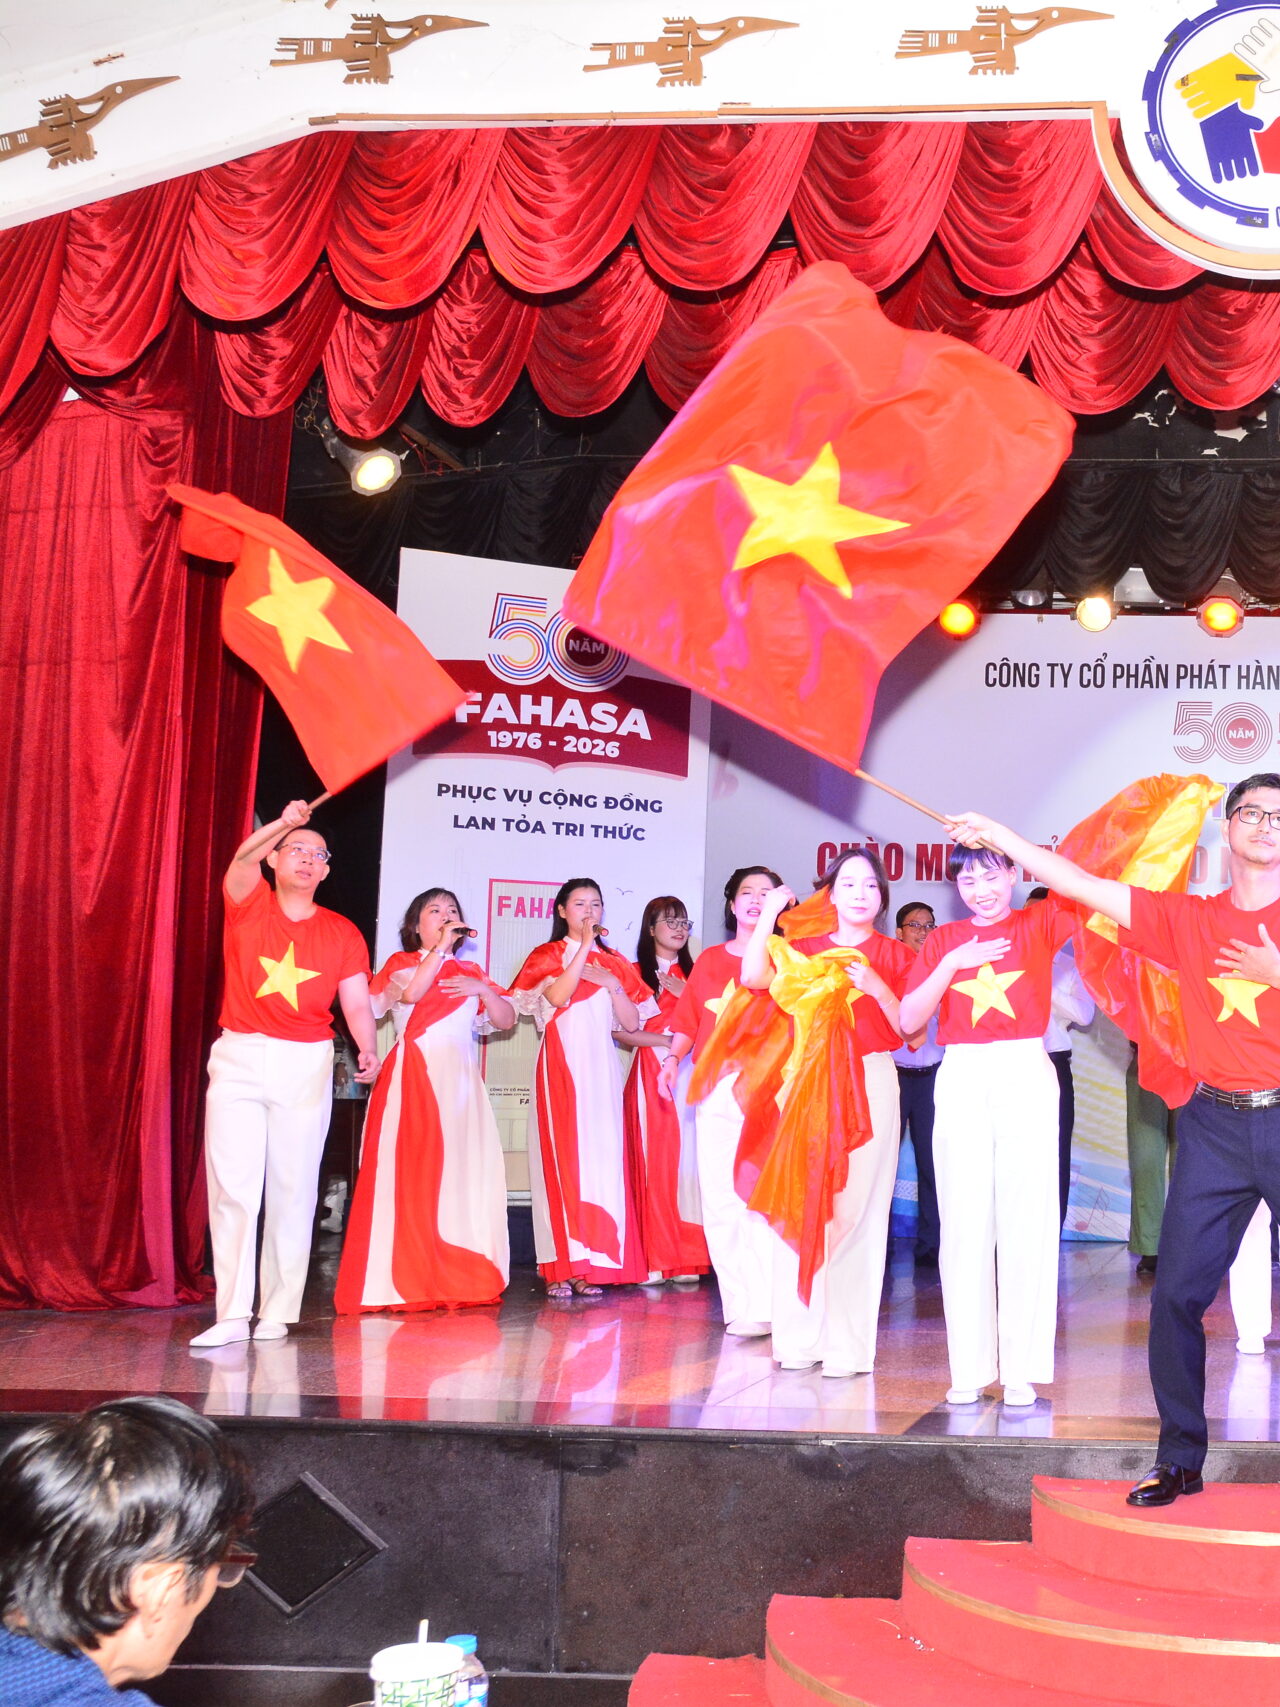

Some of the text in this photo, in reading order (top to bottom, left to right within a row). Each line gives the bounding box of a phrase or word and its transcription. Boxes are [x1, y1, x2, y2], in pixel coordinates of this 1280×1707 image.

[568, 638, 605, 654] NĂM
[984, 657, 1040, 688] CÔNG
[1046, 663, 1073, 688] TY
[1079, 653, 1108, 689] CỔ
[1112, 655, 1169, 689] PHẦN
[1176, 659, 1231, 690] PHÁT
[455, 692, 652, 741] FAHASA
[488, 730, 542, 749] 1976
[563, 735, 621, 758] 2026
[1173, 701, 1273, 765] 50
[1228, 726, 1255, 739] NĂM
[437, 783, 663, 814] PHỤC VỤ CỘNG ĐỒNG
[453, 814, 646, 842] LAN TỎA TRI THỨC
[497, 895, 555, 919] FAHA
